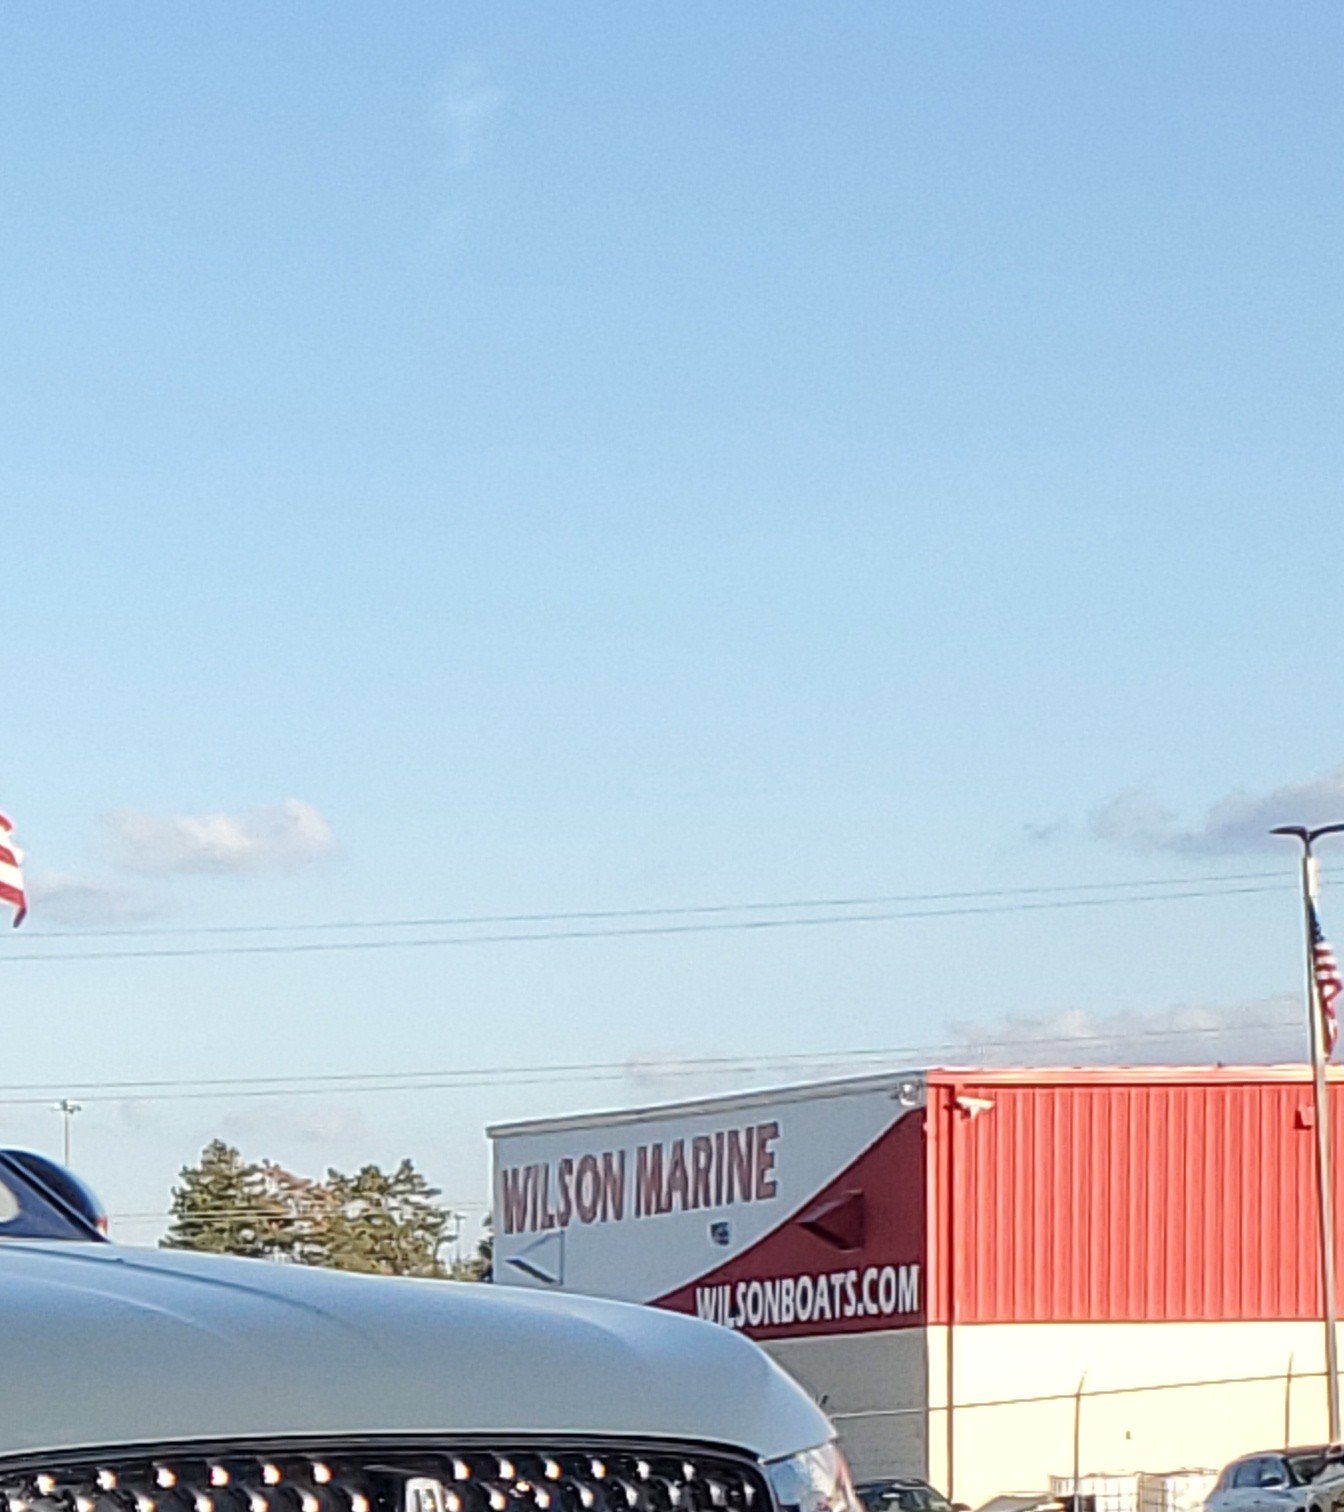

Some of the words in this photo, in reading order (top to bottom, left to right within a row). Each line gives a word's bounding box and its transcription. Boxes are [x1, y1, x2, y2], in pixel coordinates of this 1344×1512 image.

[502, 1150, 625, 1234] WILSON
[635, 1121, 779, 1218] MARINE
[696, 1265, 920, 1329] WILSONBOATS.COM
